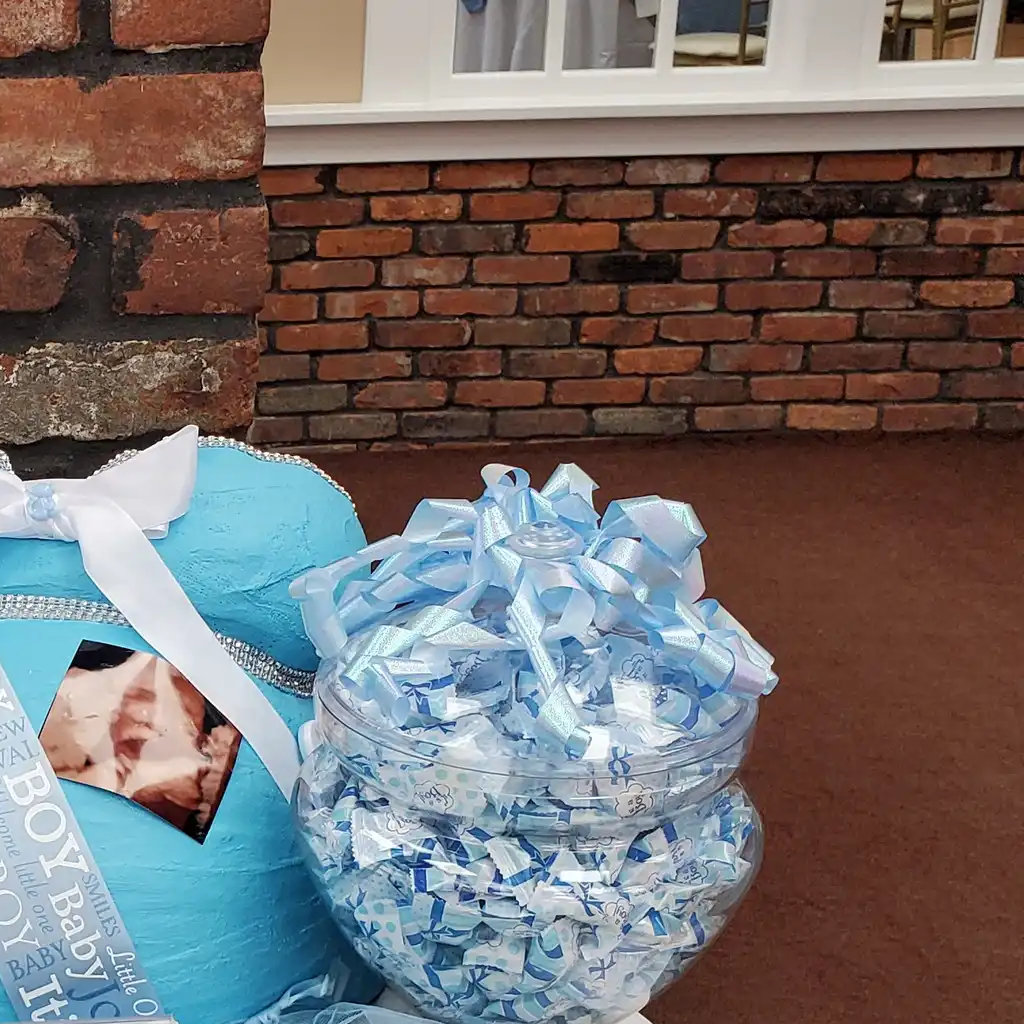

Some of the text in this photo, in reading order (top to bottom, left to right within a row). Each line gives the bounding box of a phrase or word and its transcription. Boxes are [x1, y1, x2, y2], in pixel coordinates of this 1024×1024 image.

[3, 761, 91, 879] BOY
[13, 861, 49, 899] little
[32, 904, 54, 934] one
[48, 882, 109, 981] Baby
[81, 873, 122, 938] SMILES
[5, 938, 69, 982] BABY
[106, 946, 148, 996] Little
